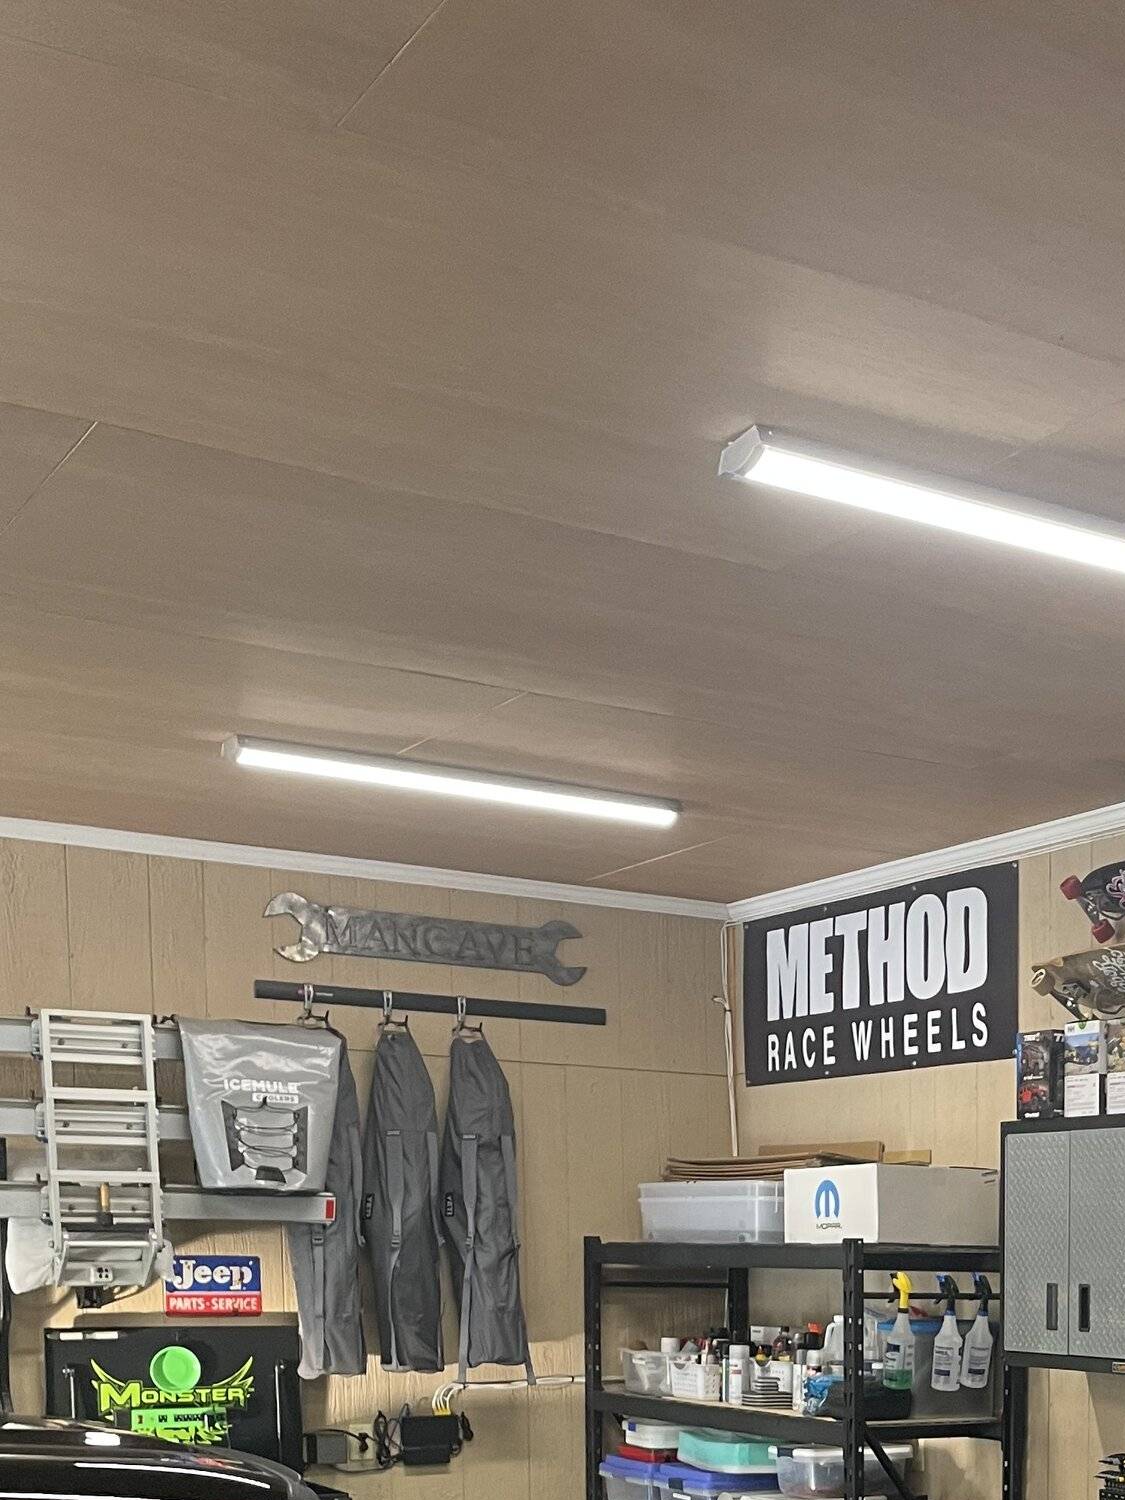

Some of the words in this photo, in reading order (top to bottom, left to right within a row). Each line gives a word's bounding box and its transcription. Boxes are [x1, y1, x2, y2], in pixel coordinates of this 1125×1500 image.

[766, 886, 989, 1023] METHOD
[767, 1025, 835, 1073] RACE
[851, 1003, 989, 1063] WHEELS
[223, 1078, 300, 1095] ICEMULE
[254, 1093, 299, 1104] COLERS
[172, 1258, 254, 1291] Jeep
[100, 1382, 246, 1412] MONSTER
